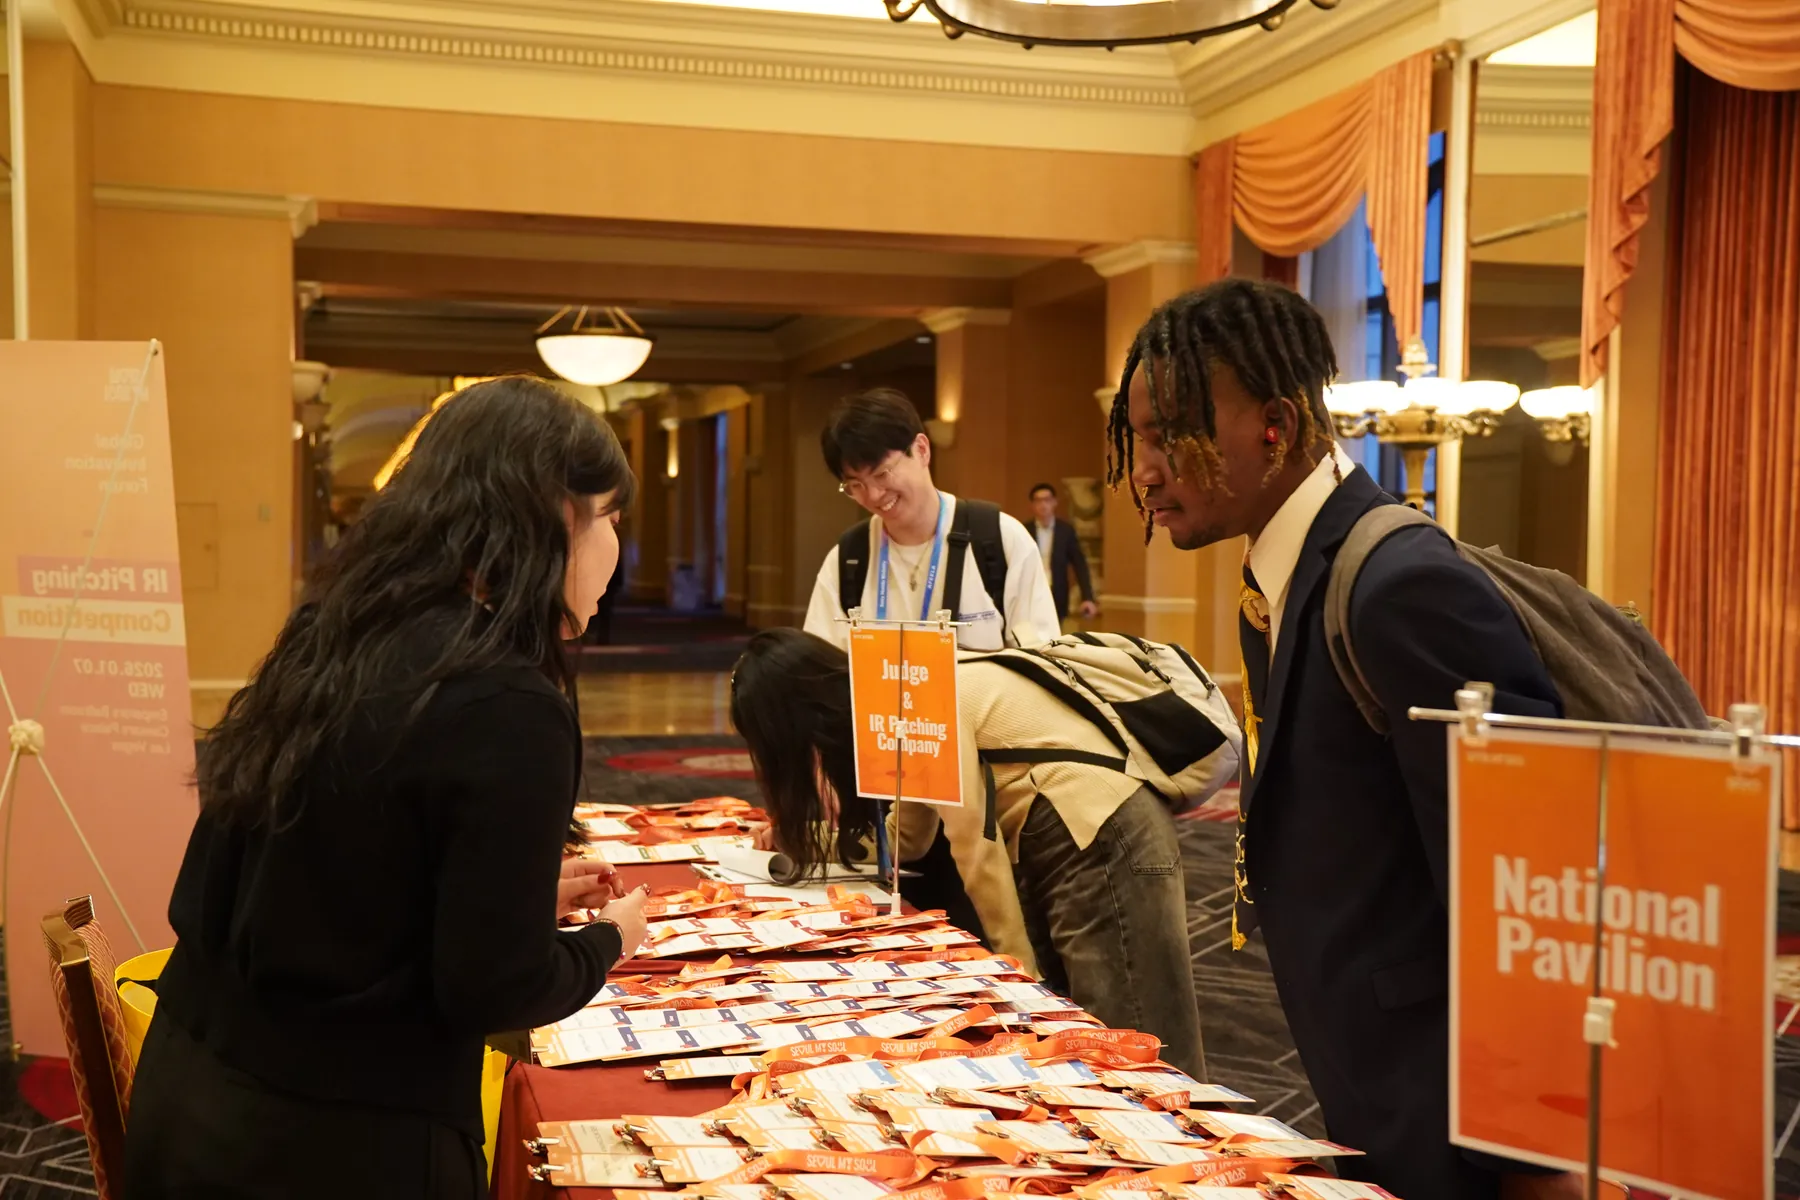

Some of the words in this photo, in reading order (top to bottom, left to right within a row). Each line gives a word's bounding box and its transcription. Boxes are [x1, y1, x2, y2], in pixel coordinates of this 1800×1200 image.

[882, 658, 929, 686] Judge
[903, 691, 913, 710] &
[869, 714, 885, 733] IR
[888, 714, 948, 741] Ptching
[1493, 853, 1721, 947] National
[1496, 915, 1716, 1011] Pavilion
[814, 1043, 828, 1055] MY
[906, 1041, 920, 1053] MY
[837, 1156, 853, 1169] MY
[853, 1157, 878, 1173] SOUL
